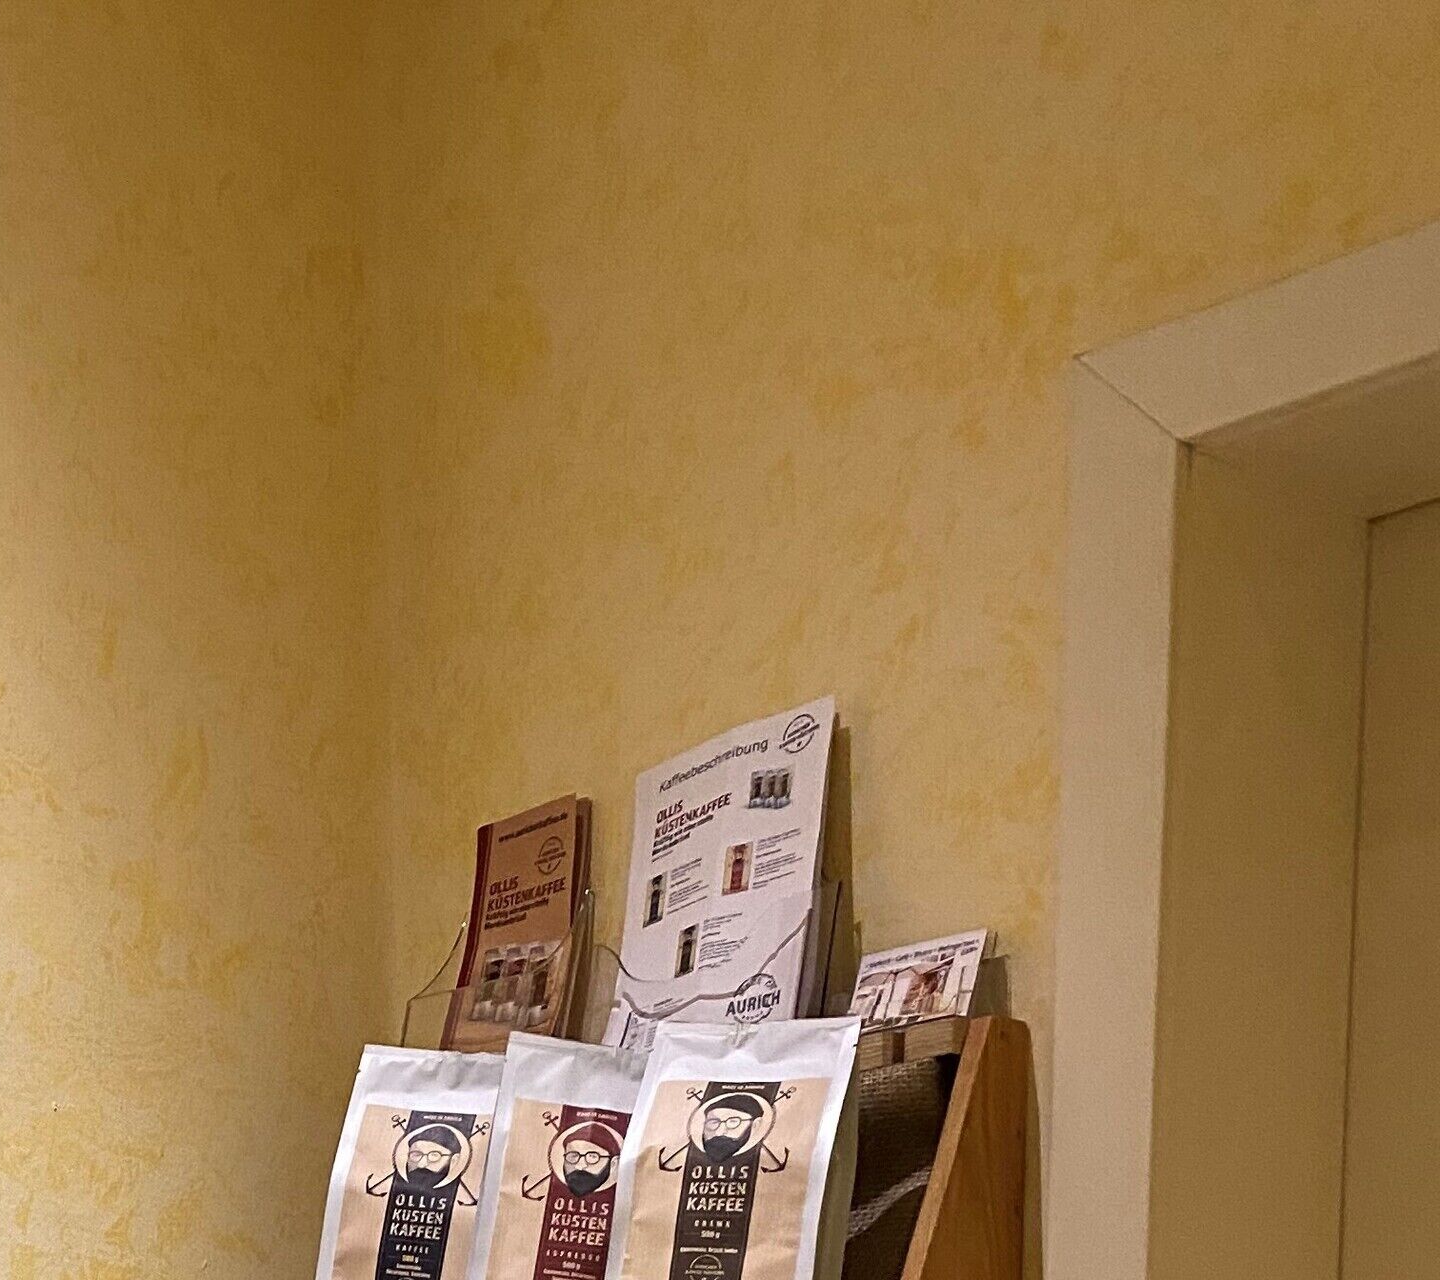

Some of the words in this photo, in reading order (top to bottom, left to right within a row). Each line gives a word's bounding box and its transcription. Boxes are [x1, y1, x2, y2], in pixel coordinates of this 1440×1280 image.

[659, 739, 768, 793] Kaffeebeschreibung
[725, 990, 781, 1017] AURICH
[691, 1165, 750, 1179] OLLIS
[395, 1193, 447, 1210] OLLIS
[554, 1197, 610, 1215] OLLIS
[686, 1197, 745, 1212] KAFFEE
[389, 1222, 443, 1240] KAFFEE
[548, 1227, 605, 1246] KAFFEE
